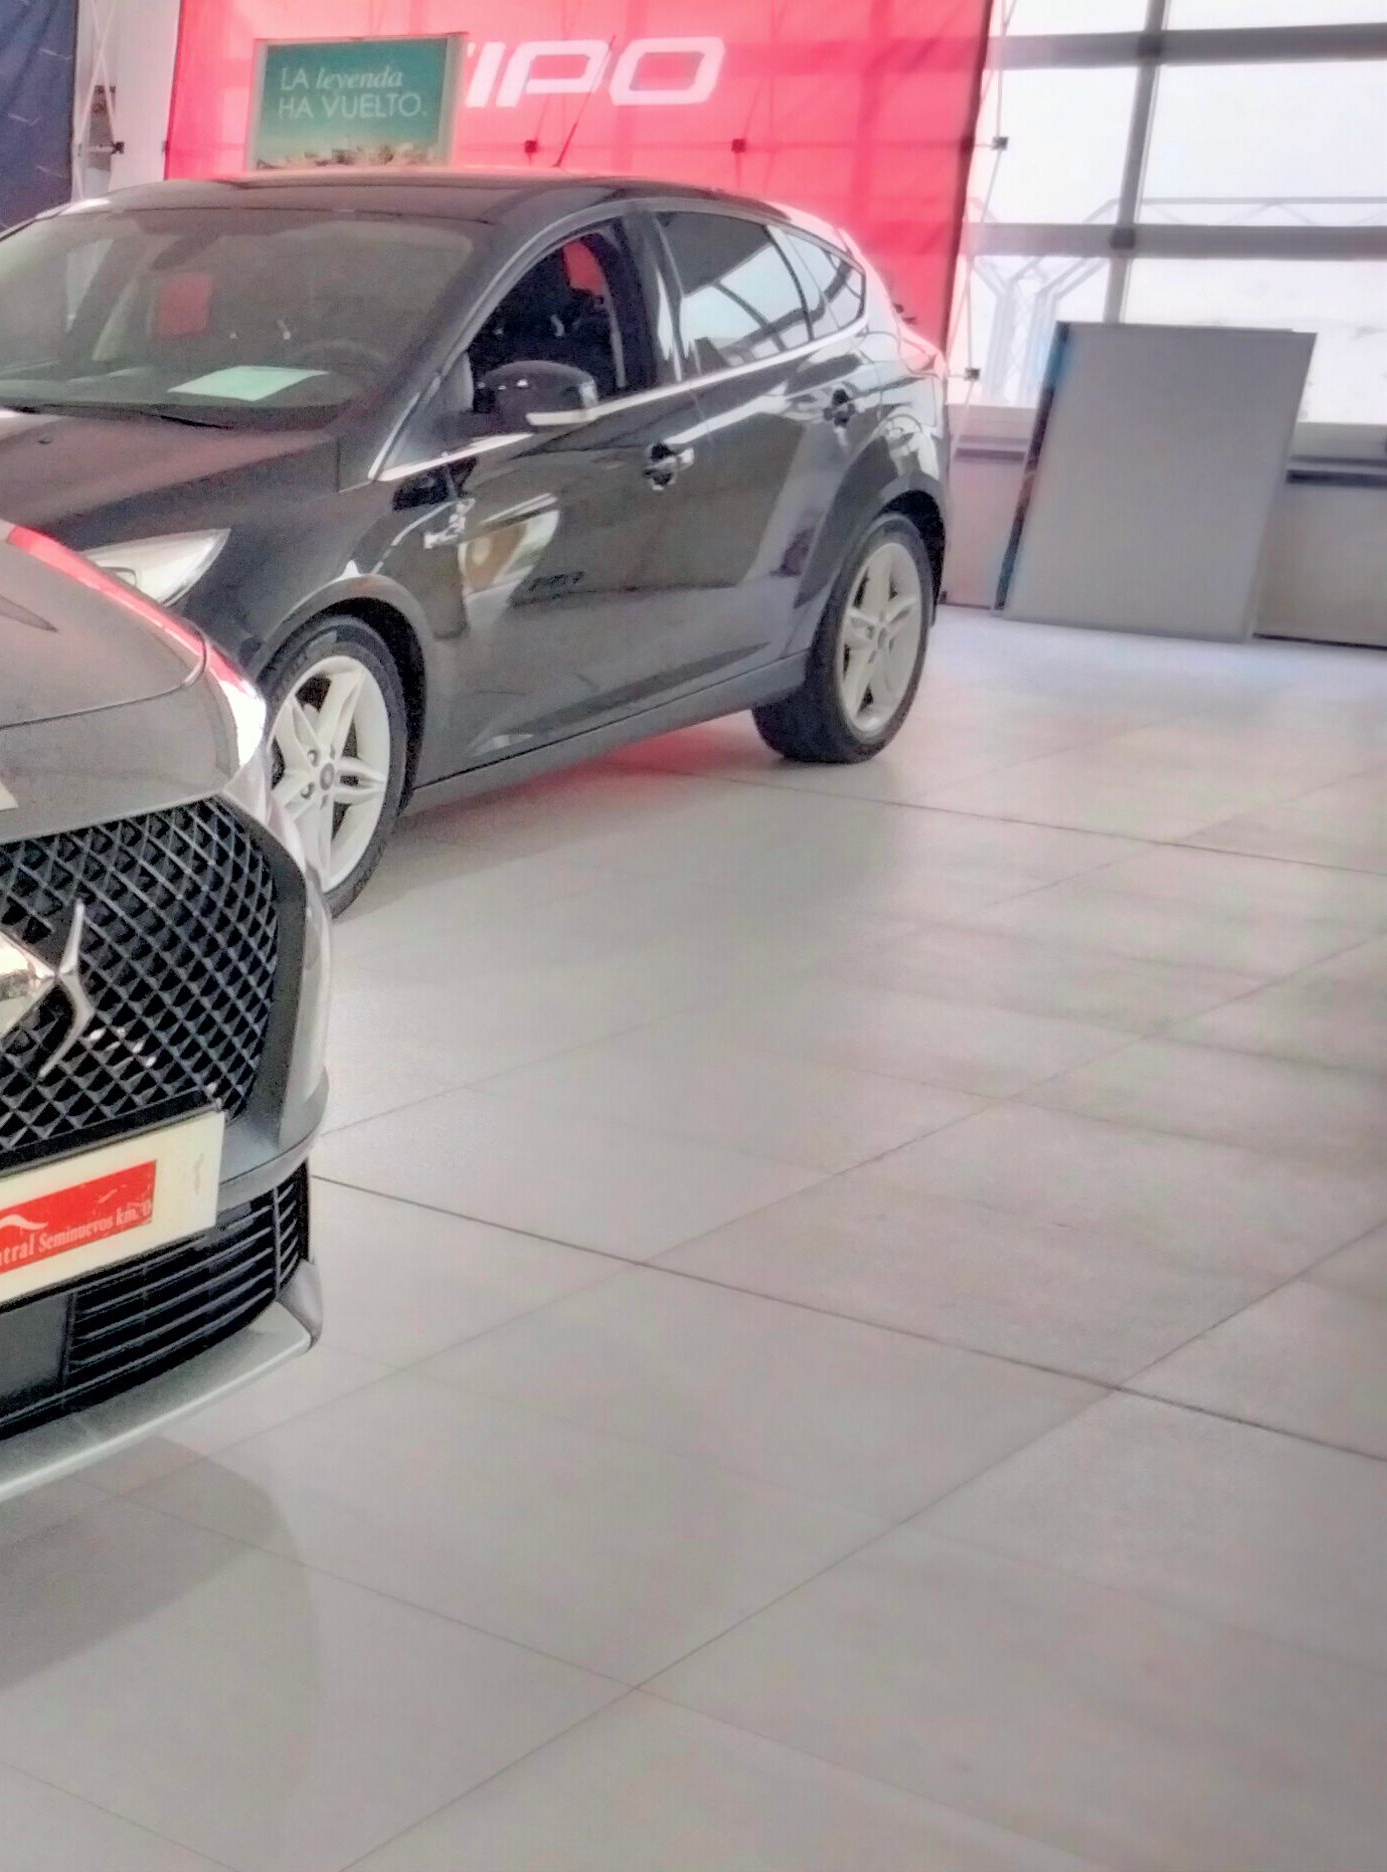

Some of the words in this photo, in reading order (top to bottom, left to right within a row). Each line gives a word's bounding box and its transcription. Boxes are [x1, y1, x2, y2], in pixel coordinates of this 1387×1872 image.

[280, 67, 310, 91] LA
[315, 64, 404, 96] leyenda
[464, 36, 726, 108] IPO
[278, 96, 315, 119] HA
[321, 92, 429, 118] VUELTO.
[38, 1214, 114, 1251] Seminuevos
